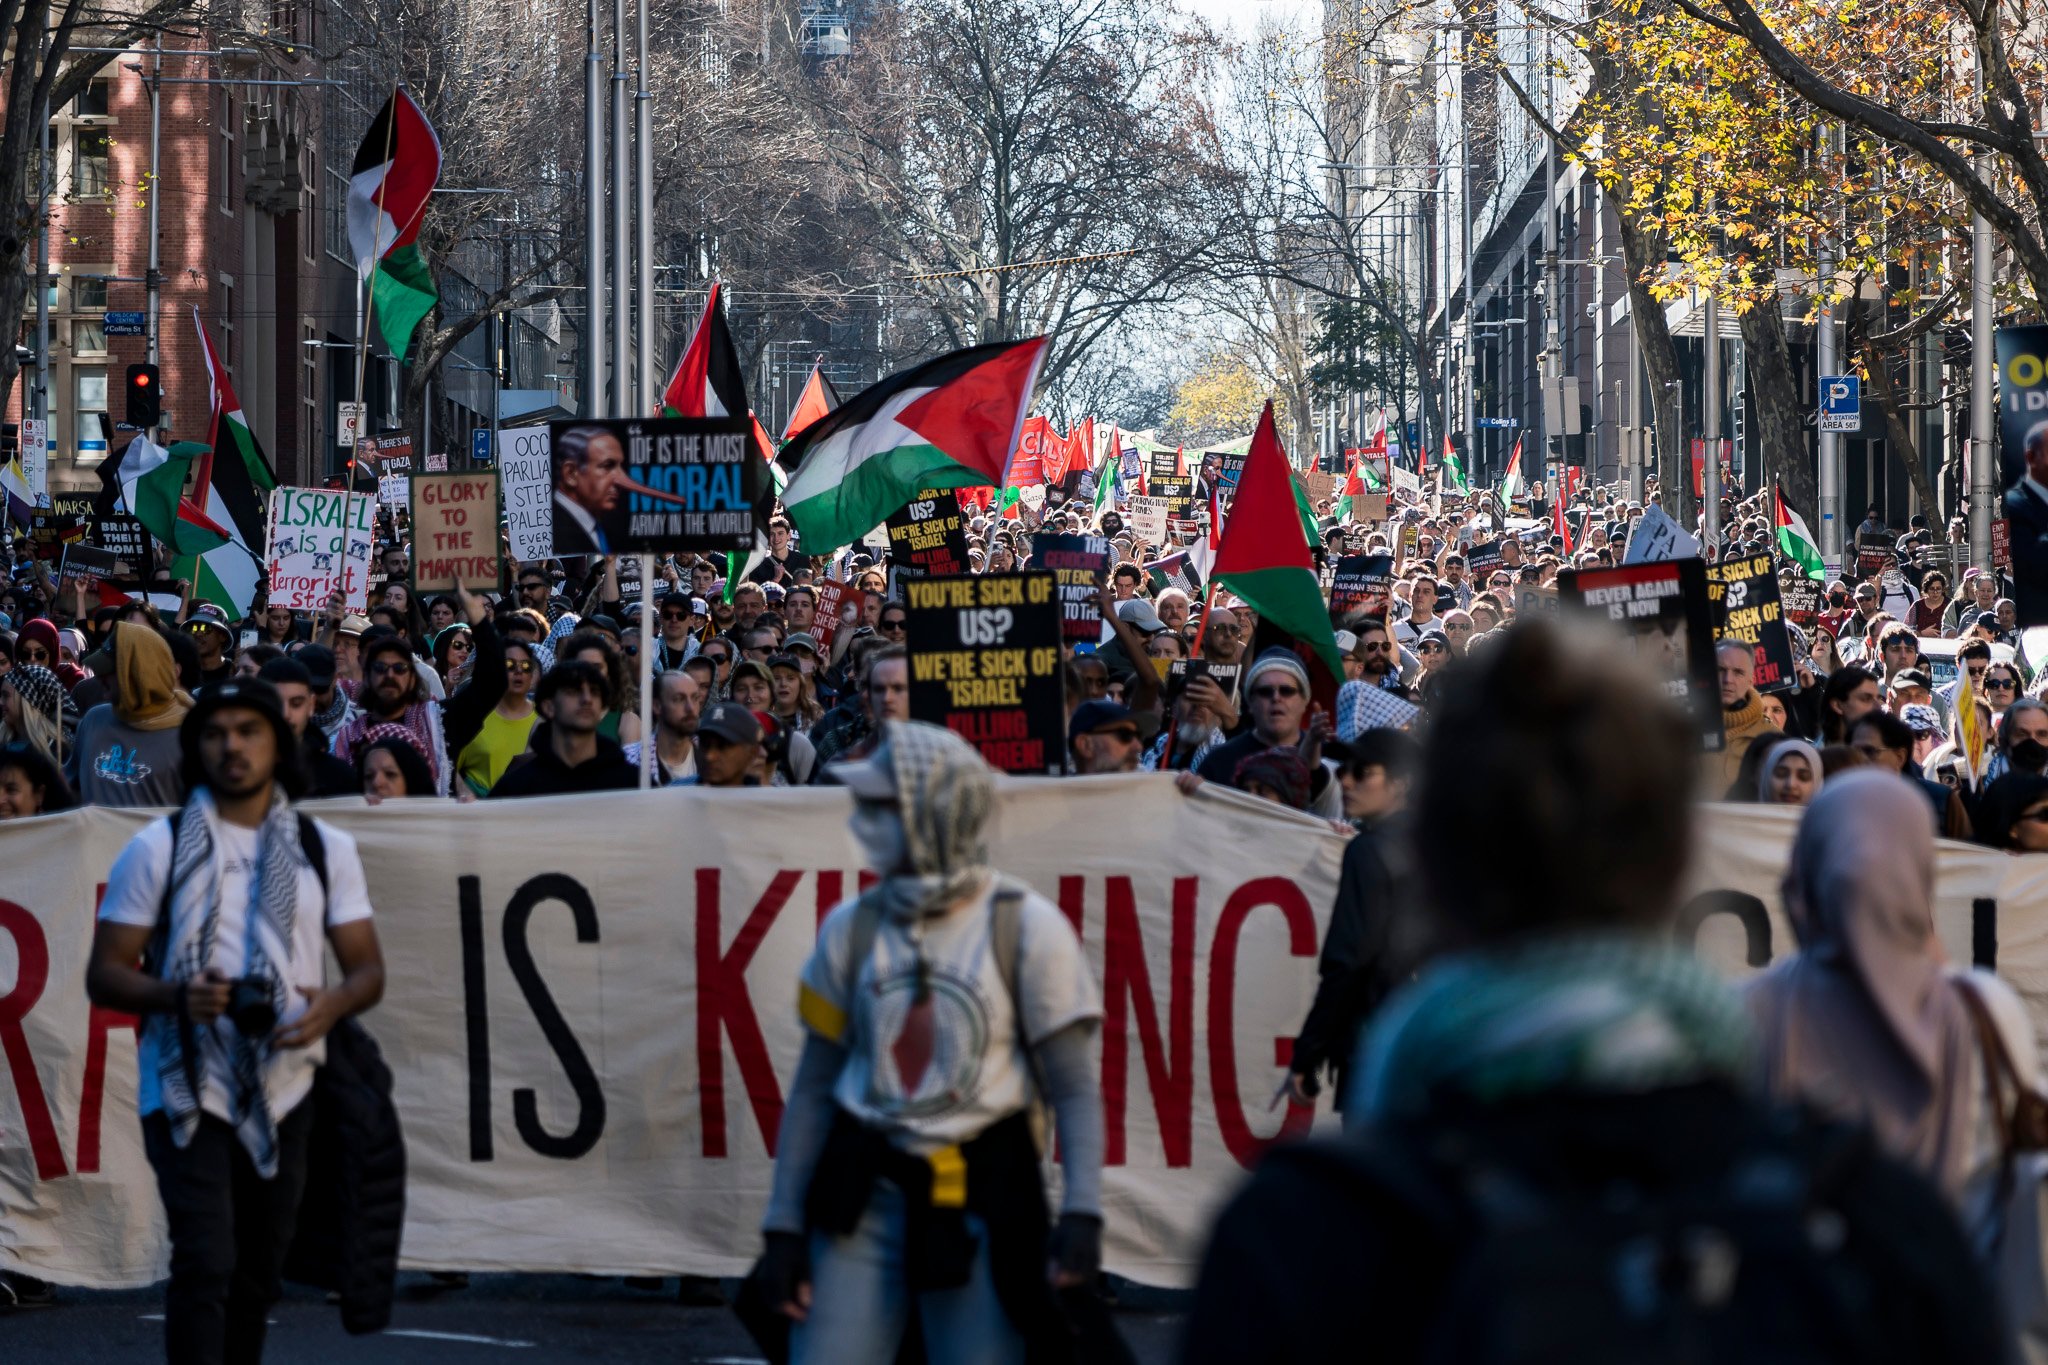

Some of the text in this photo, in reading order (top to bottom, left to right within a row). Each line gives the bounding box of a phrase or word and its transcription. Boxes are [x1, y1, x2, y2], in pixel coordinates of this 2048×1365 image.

[2007, 353, 2048, 387] O
[1829, 383, 1850, 409] P
[2025, 390, 2048, 411] D
[1821, 421, 1843, 429] AREA
[379, 436, 411, 449] THERE'S NO
[477, 432, 486, 442] P
[515, 433, 549, 456] OCC
[656, 436, 672, 463] IS
[675, 435, 701, 463] THE
[704, 433, 747, 463] MOST
[23, 466, 34, 474] 2P
[382, 459, 390, 471] IN
[391, 456, 411, 469] GAZA
[504, 459, 551, 483] PARLIA
[629, 463, 752, 513] MORAL
[1151, 476, 1191, 485] YOU'RE SICK OF
[423, 482, 489, 505] GLORY
[1024, 493, 1044, 504] Gaza
[1163, 485, 1180, 496] US?
[53, 499, 97, 517] WARSA
[1184, 496, 1191, 505] OF
[279, 489, 370, 532] ISRAEL
[440, 508, 467, 526] TO
[509, 508, 552, 530] PALES
[908, 500, 936, 521] US?
[629, 512, 751, 536] ARMY IN THE WORLD
[889, 516, 960, 541] WE'RE SICK OF
[1991, 523, 2005, 533] END
[299, 529, 317, 553] is
[433, 531, 474, 550] THE
[908, 532, 947, 551] 'ISRAEL'
[1084, 536, 1109, 554] THE
[1992, 531, 2005, 541] THE
[1993, 538, 2010, 549] SIEGE
[1993, 549, 2003, 557] ON
[1994, 554, 2010, 564] GAZA
[87, 566, 112, 576] SINGLE
[271, 559, 357, 594] terrorist
[418, 556, 498, 581] MARTYRS
[1056, 569, 1071, 585] OT
[1722, 557, 1771, 583] SICK OF
[621, 579, 670, 592] 1945 025
[1334, 582, 1365, 592] HUMAN
[1361, 574, 1389, 584] SINGLE
[1778, 579, 1792, 587] EY
[290, 588, 337, 609] sta
[821, 585, 842, 600] END
[906, 577, 1053, 609] YOU'RE SICK OF
[1346, 592, 1375, 602] GAZA
[1584, 578, 1680, 606] NEVER AGAIN
[1707, 584, 1726, 601] OF
[1726, 581, 1748, 608] S?
[818, 598, 837, 615] THE
[1063, 602, 1102, 620] TO THE
[1608, 599, 1660, 620] IS NOW
[1728, 601, 1780, 630] SICK OF
[814, 612, 840, 631] SIEGE
[958, 608, 1014, 645] US?
[810, 625, 825, 641] ON
[913, 648, 1058, 681] WE'RE SICK OF
[1207, 664, 1237, 677] AGAIN
[946, 678, 1027, 707] 'ISRAEL'
[947, 709, 1029, 741] KILLING
[979, 739, 1045, 770] DREN!
[457, 872, 607, 1163] IS
